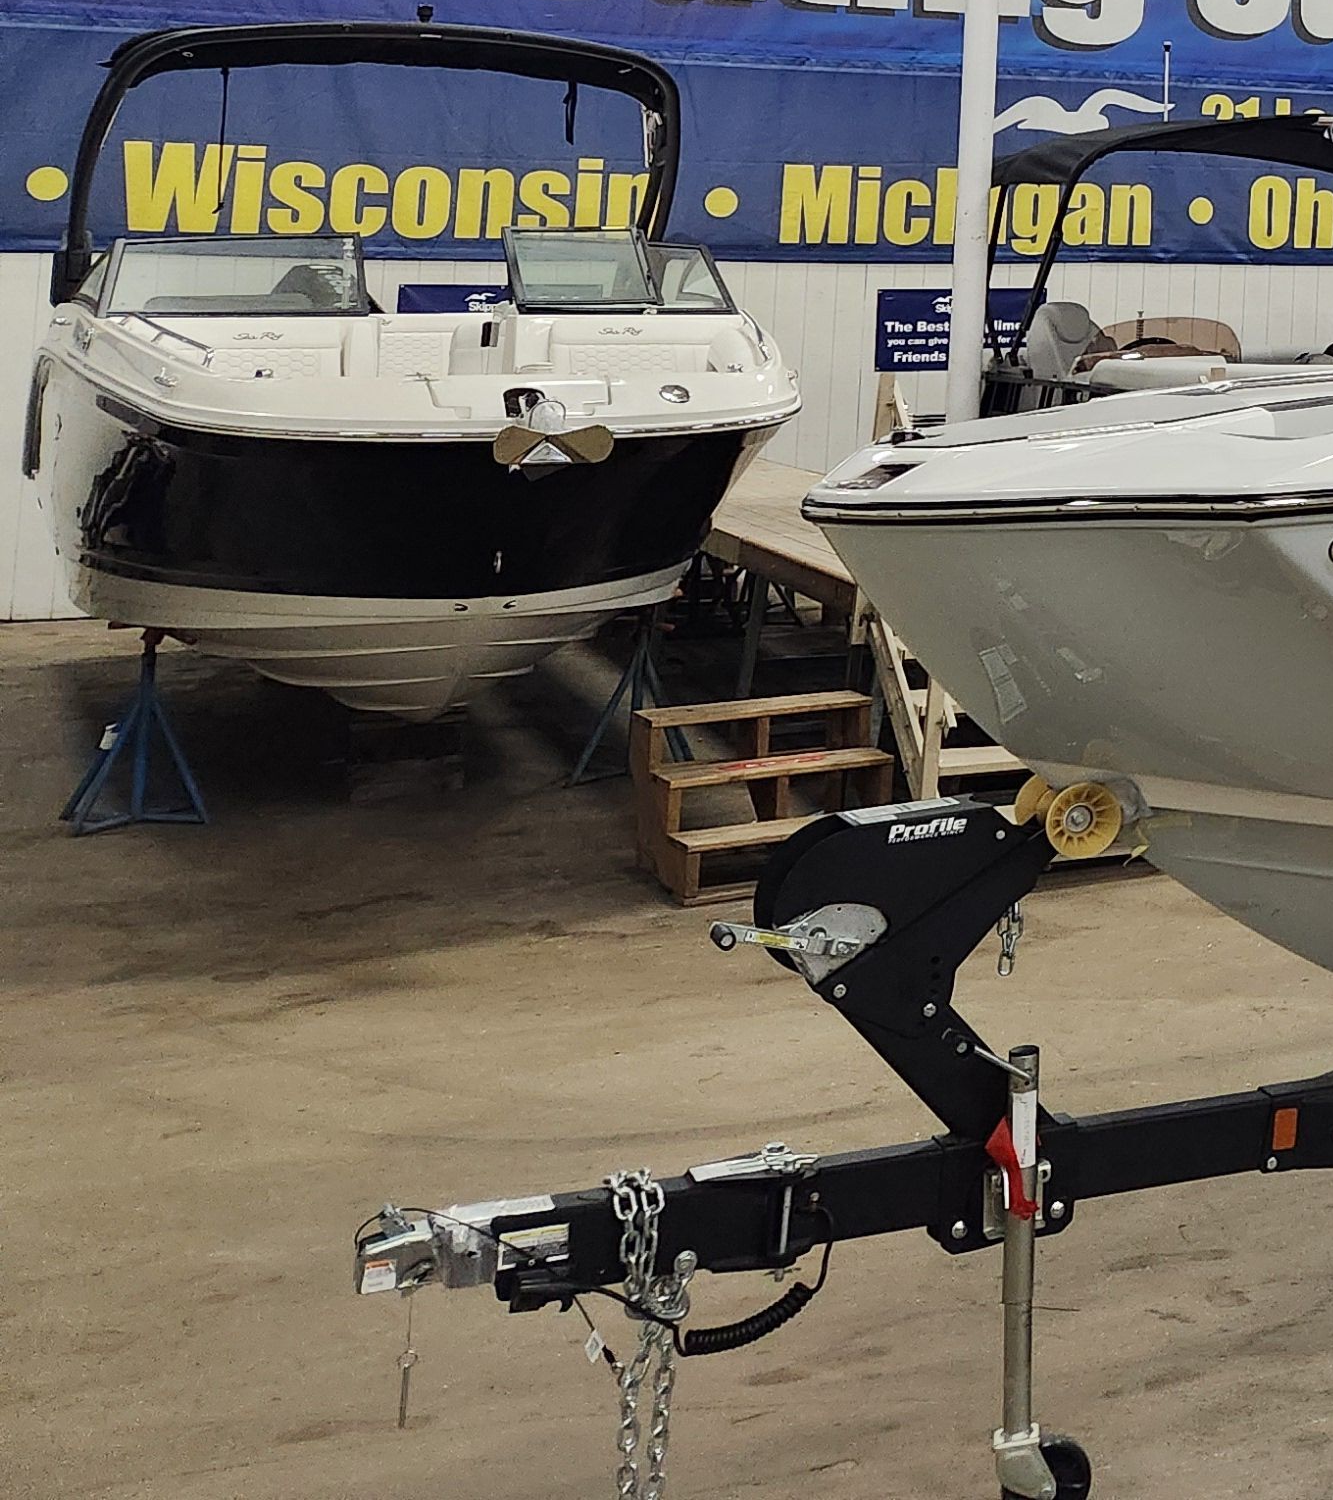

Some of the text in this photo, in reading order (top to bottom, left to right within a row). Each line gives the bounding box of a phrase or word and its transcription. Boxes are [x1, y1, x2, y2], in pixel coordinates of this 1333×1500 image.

[123, 140, 651, 238] Wisconsin
[885, 321, 950, 333] The Best
[887, 339, 906, 348] you
[928, 336, 949, 347] give
[893, 350, 947, 363] Friends
[888, 816, 968, 840] Profile
